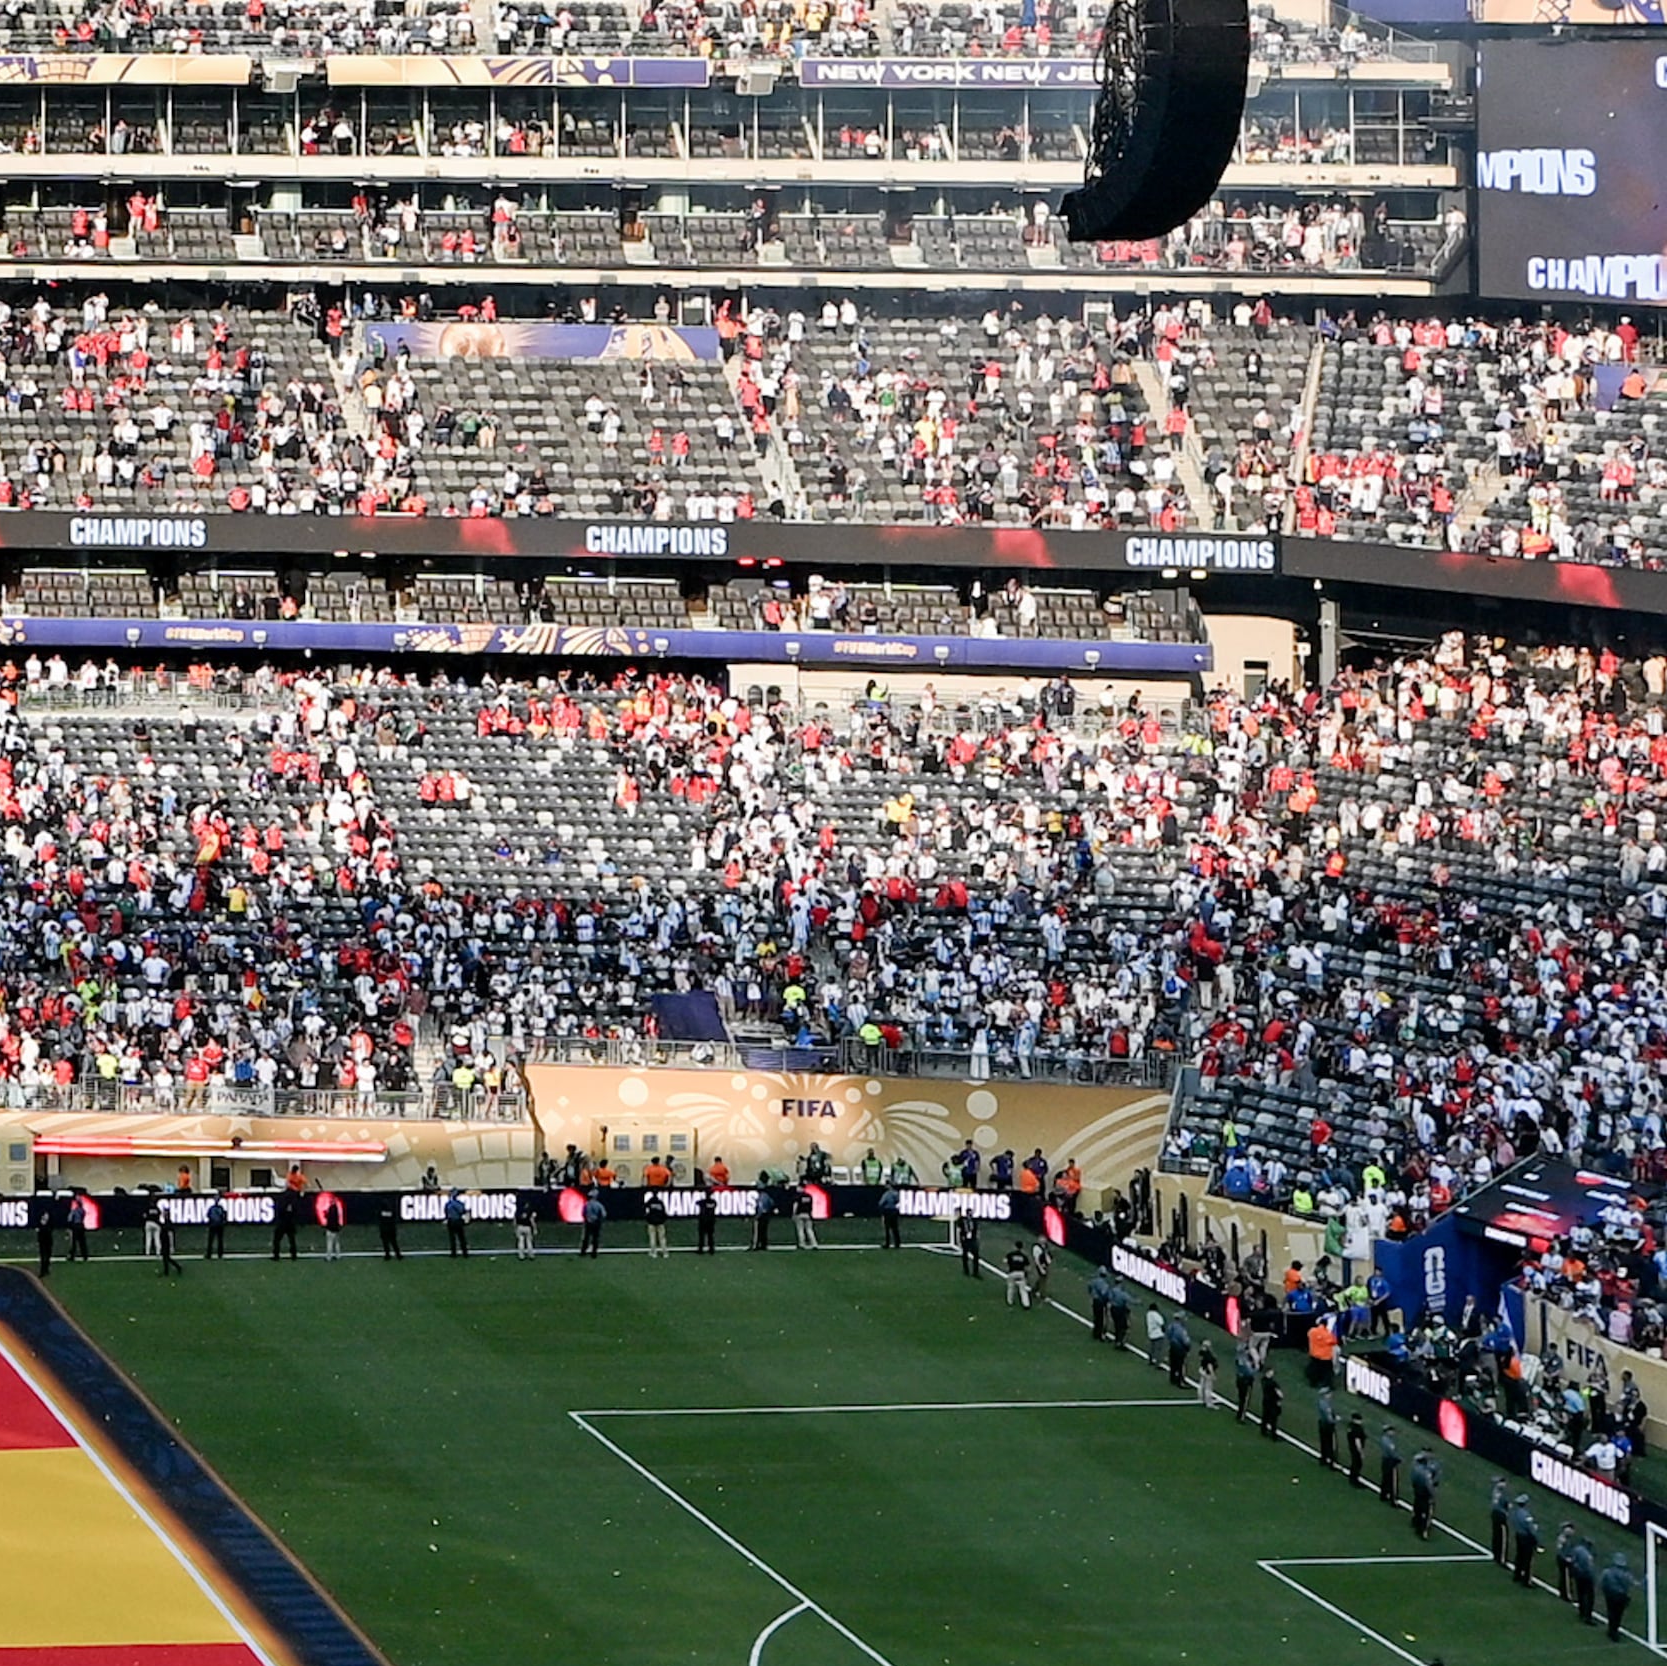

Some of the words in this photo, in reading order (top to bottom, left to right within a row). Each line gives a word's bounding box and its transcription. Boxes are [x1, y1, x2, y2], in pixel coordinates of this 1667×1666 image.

[816, 65, 884, 81] NEW
[892, 65, 978, 81] YORK
[982, 65, 1050, 81] NEW
[69, 515, 206, 549] CHAMPIONS
[586, 525, 727, 557] CHAMPIONS
[1126, 535, 1274, 571] CHAMPIONS
[781, 1098, 837, 1118] FIFA
[899, 1190, 1012, 1220] HAMPIONS
[1111, 1244, 1186, 1304] CHAMPIONS
[1566, 1338, 1608, 1375] FIFA
[1530, 1449, 1629, 1525] CHAMPIONS
